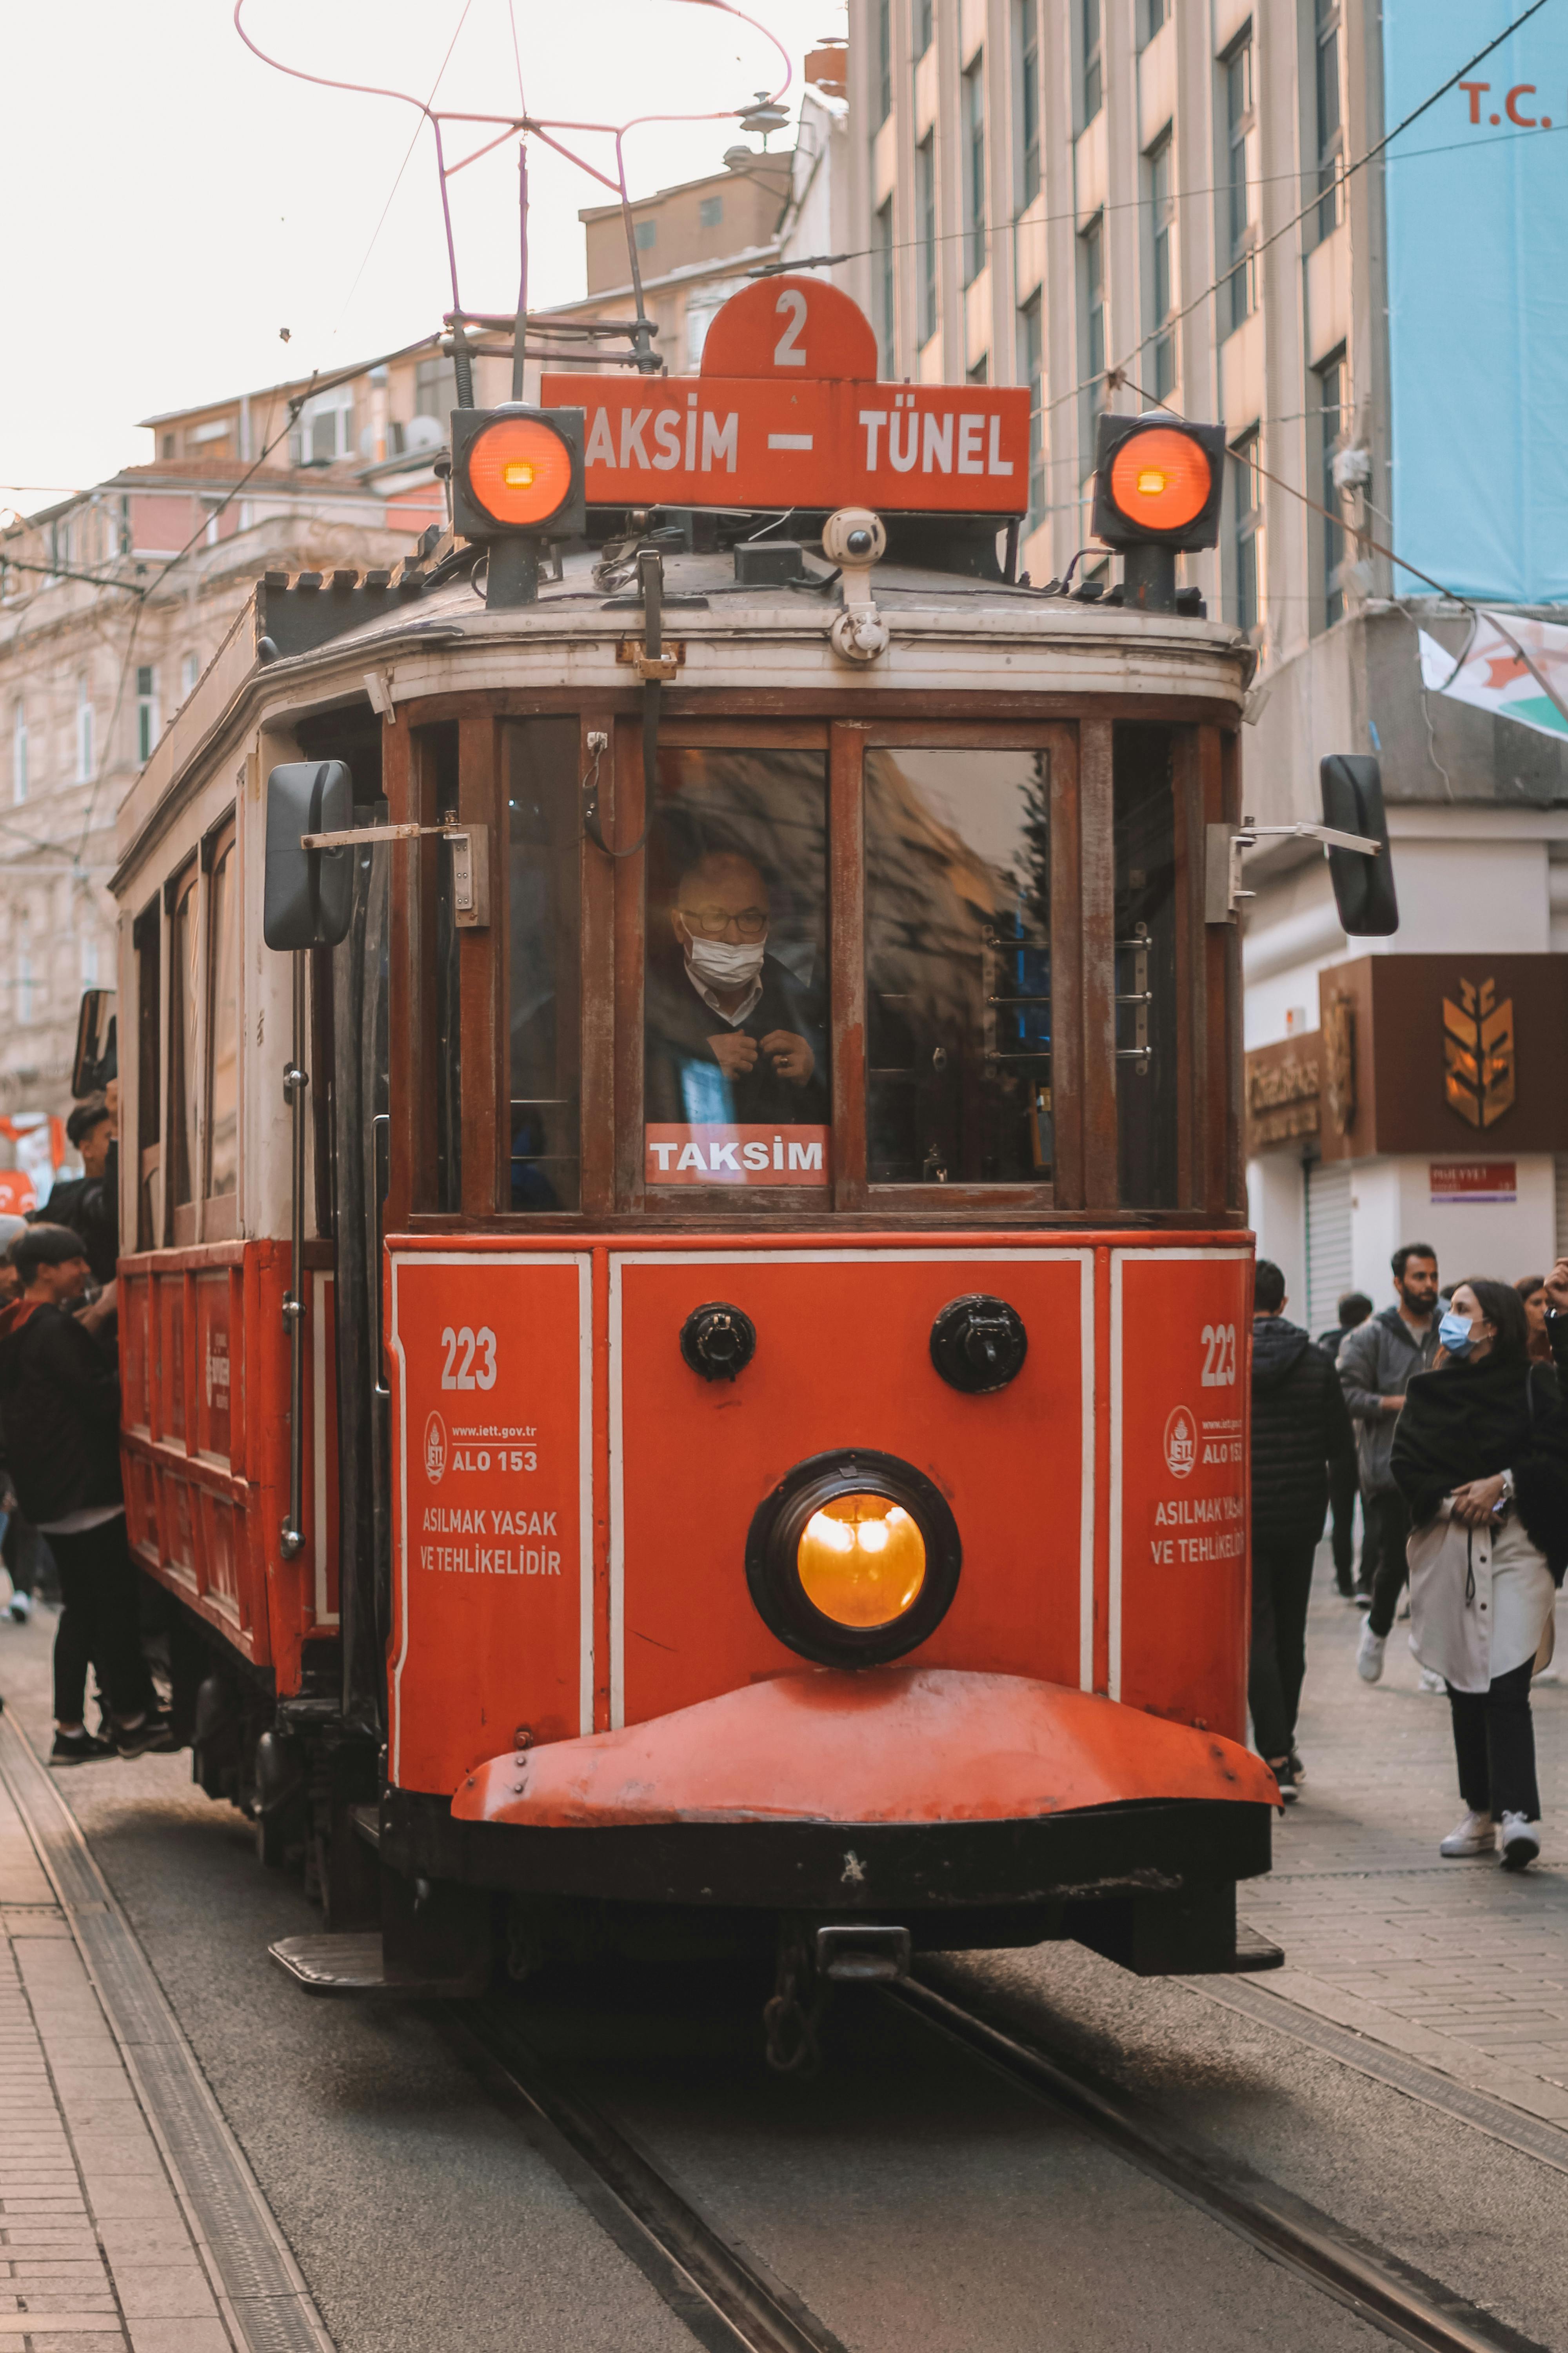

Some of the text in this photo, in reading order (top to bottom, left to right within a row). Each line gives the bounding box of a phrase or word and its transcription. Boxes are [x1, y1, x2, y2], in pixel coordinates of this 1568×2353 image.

[1459, 82, 1552, 129] T.C.
[774, 289, 808, 366] 2
[560, 393, 739, 473] AKSİM
[859, 394, 1014, 476] TÜNEL
[650, 1135, 822, 1171] TAKSİM
[441, 1326, 497, 1390] 223
[1201, 1323, 1236, 1386] 223
[452, 1425, 537, 1438] www.iett.gov.tr
[452, 1451, 537, 1471] ALO 153
[1202, 1444, 1228, 1464] ALO
[423, 1508, 557, 1536] ASILMAK YASAK
[1155, 1498, 1222, 1526] ASILMAK
[421, 1543, 561, 1575] VE TEHLİKELİDİR
[1150, 1540, 1173, 1565] VE
